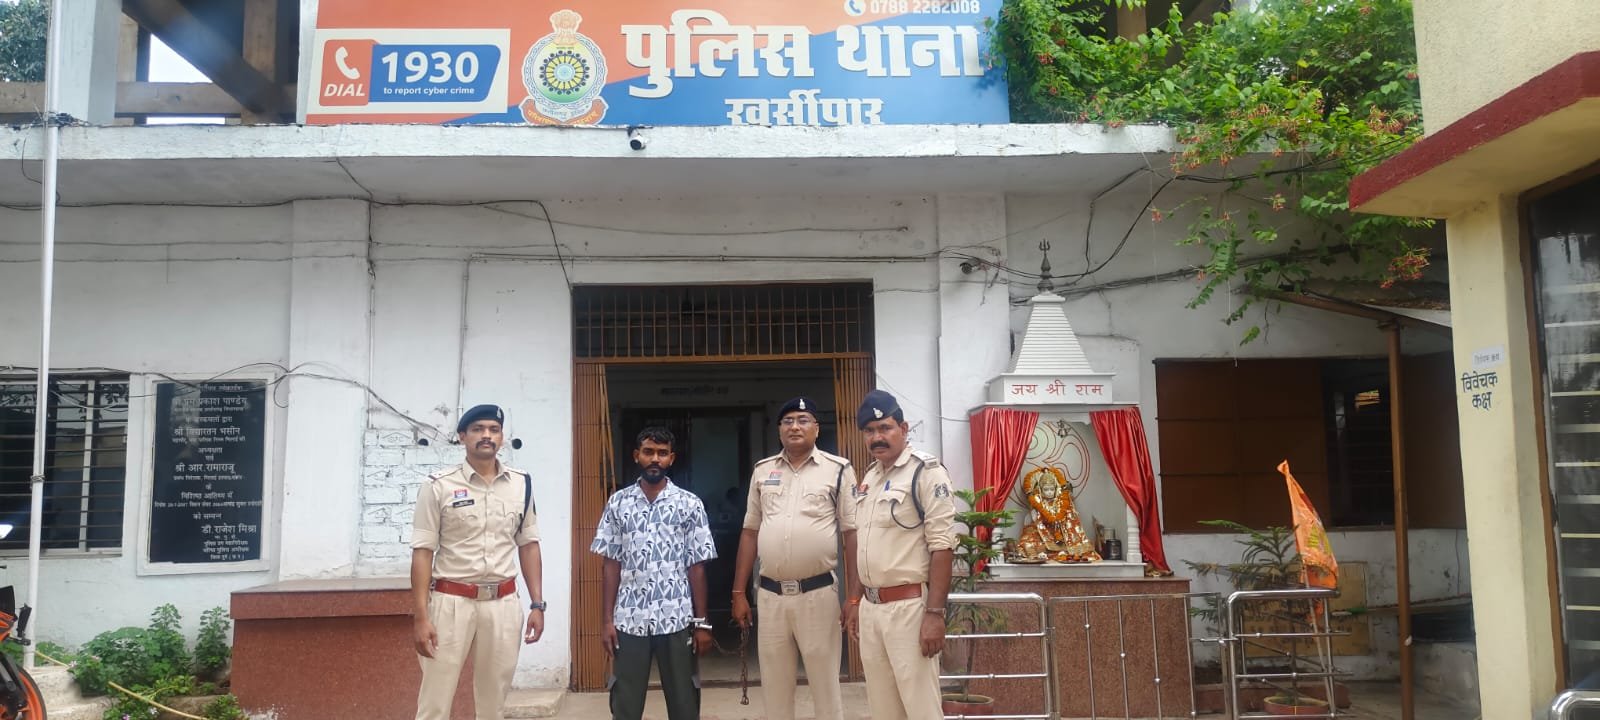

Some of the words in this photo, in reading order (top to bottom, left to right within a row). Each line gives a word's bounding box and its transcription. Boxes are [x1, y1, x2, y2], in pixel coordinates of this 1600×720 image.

[621, 9, 815, 98] पुलिस
[837, 25, 984, 78] थाना
[381, 51, 479, 83] 1930
[324, 83, 366, 97] DIAL
[383, 87, 392, 95] to
[394, 86, 422, 98] report
[424, 86, 449, 98] cyber
[450, 86, 475, 95] crime
[1011, 384, 1038, 396] जय
[1046, 379, 1066, 396] श्री
[1075, 384, 1104, 396] राम
[1461, 370, 1498, 393] विवेचक
[1472, 391, 1492, 411] कक्ष
[174, 426, 183, 436] श्री
[220, 425, 240, 436] भसीन
[175, 462, 185, 472] श्री
